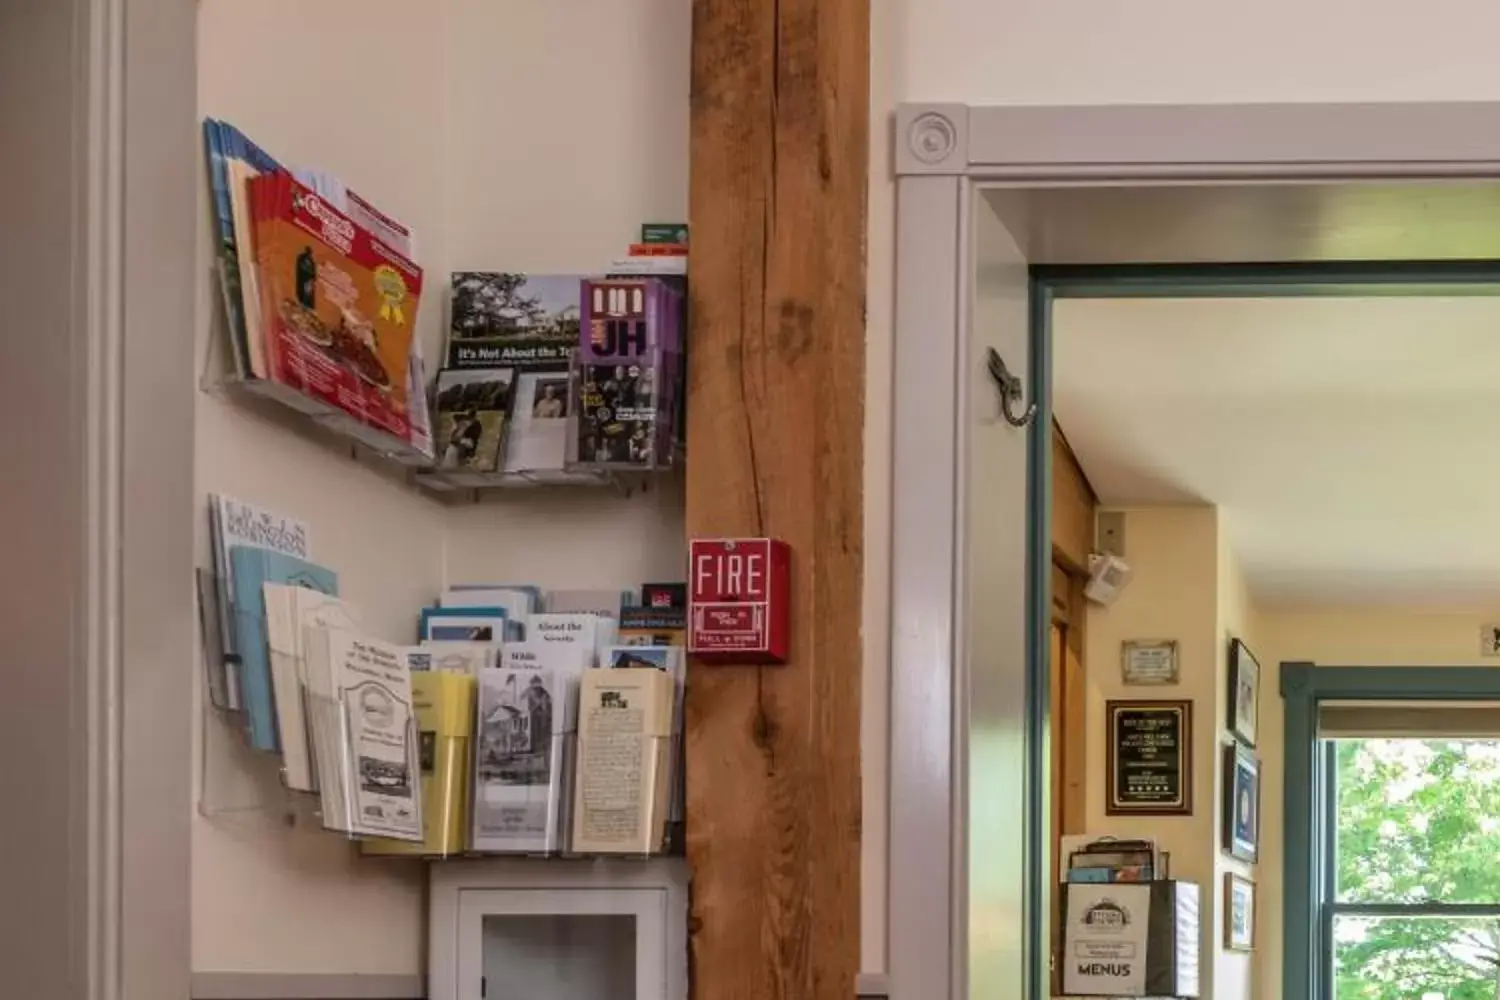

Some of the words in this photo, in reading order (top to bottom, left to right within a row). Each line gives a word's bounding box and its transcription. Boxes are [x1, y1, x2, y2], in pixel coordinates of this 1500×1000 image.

[502, 347, 535, 359] About
[538, 346, 557, 357] the
[697, 555, 762, 595] FIRE
[1077, 963, 1131, 977] MENUS
